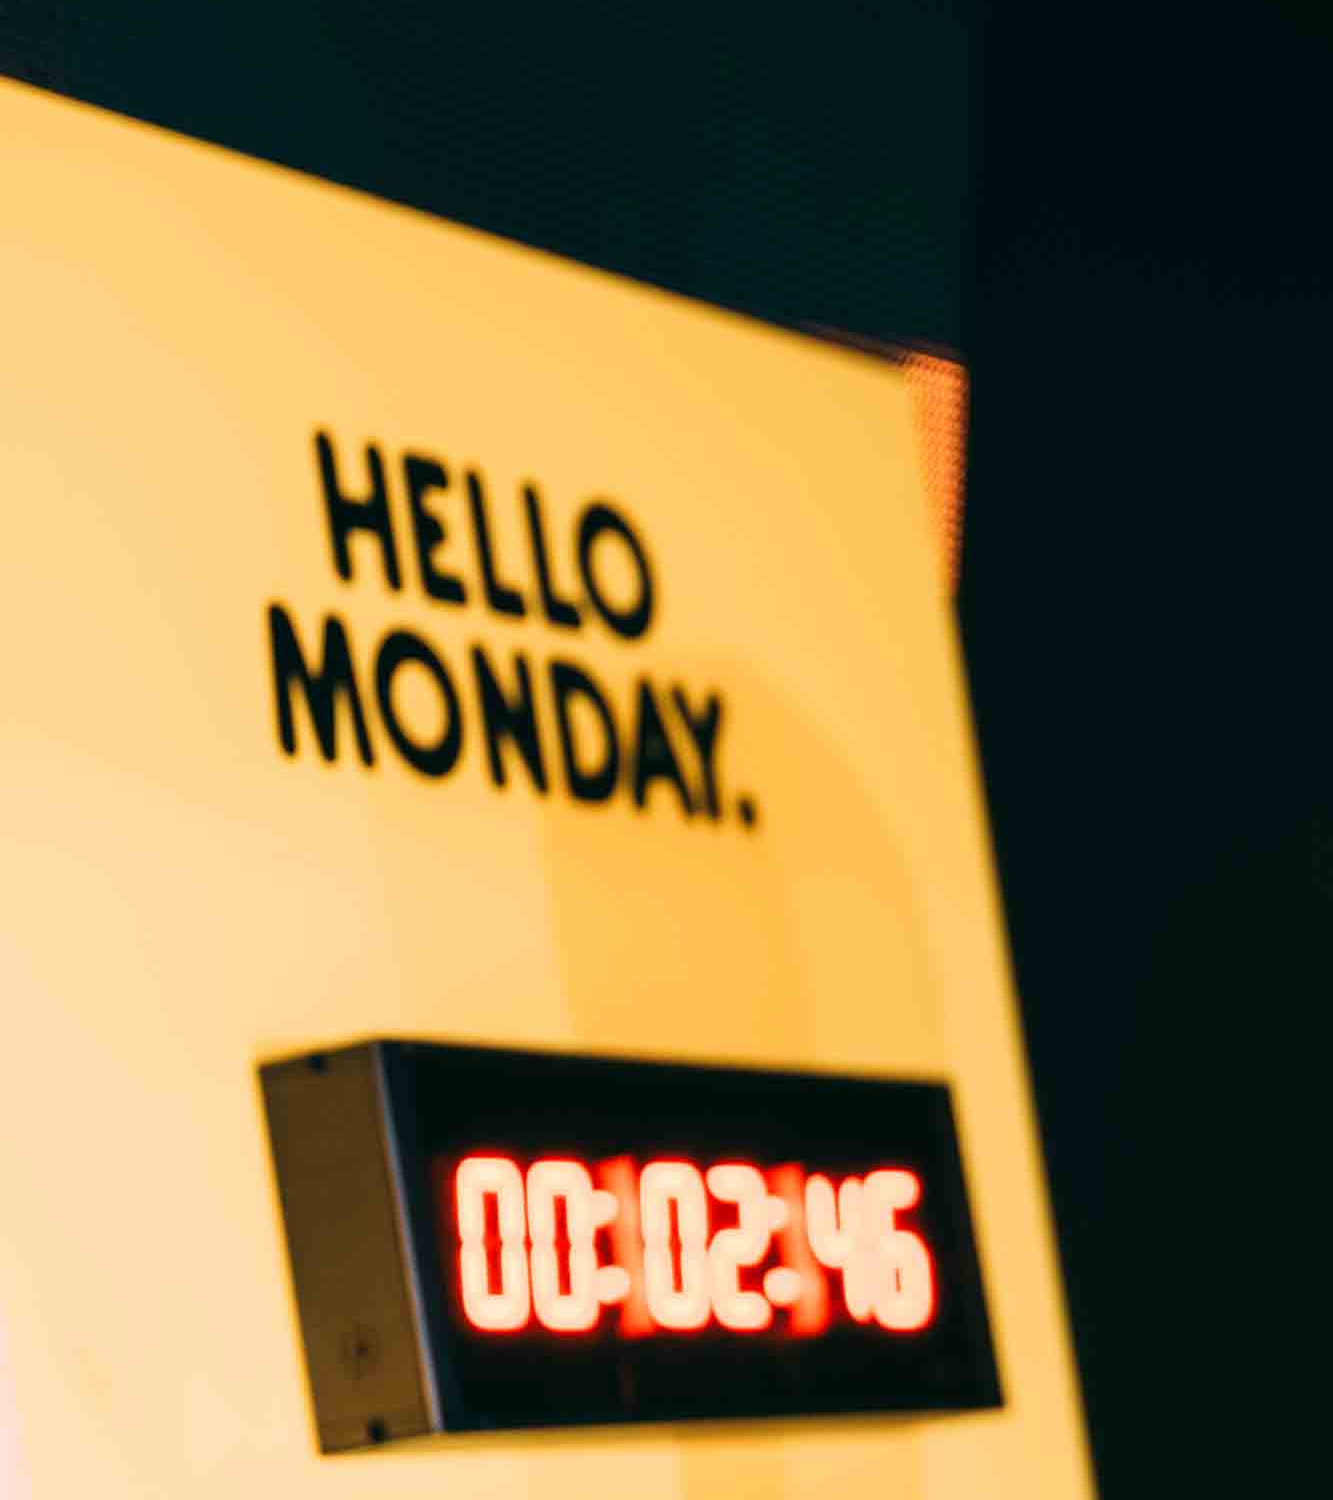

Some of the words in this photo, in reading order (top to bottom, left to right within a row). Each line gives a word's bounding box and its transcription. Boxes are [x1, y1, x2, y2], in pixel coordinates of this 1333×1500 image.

[313, 430, 655, 641] HELLO
[266, 602, 759, 832] MONDAY.
[455, 1155, 937, 1332] 00:02:46
